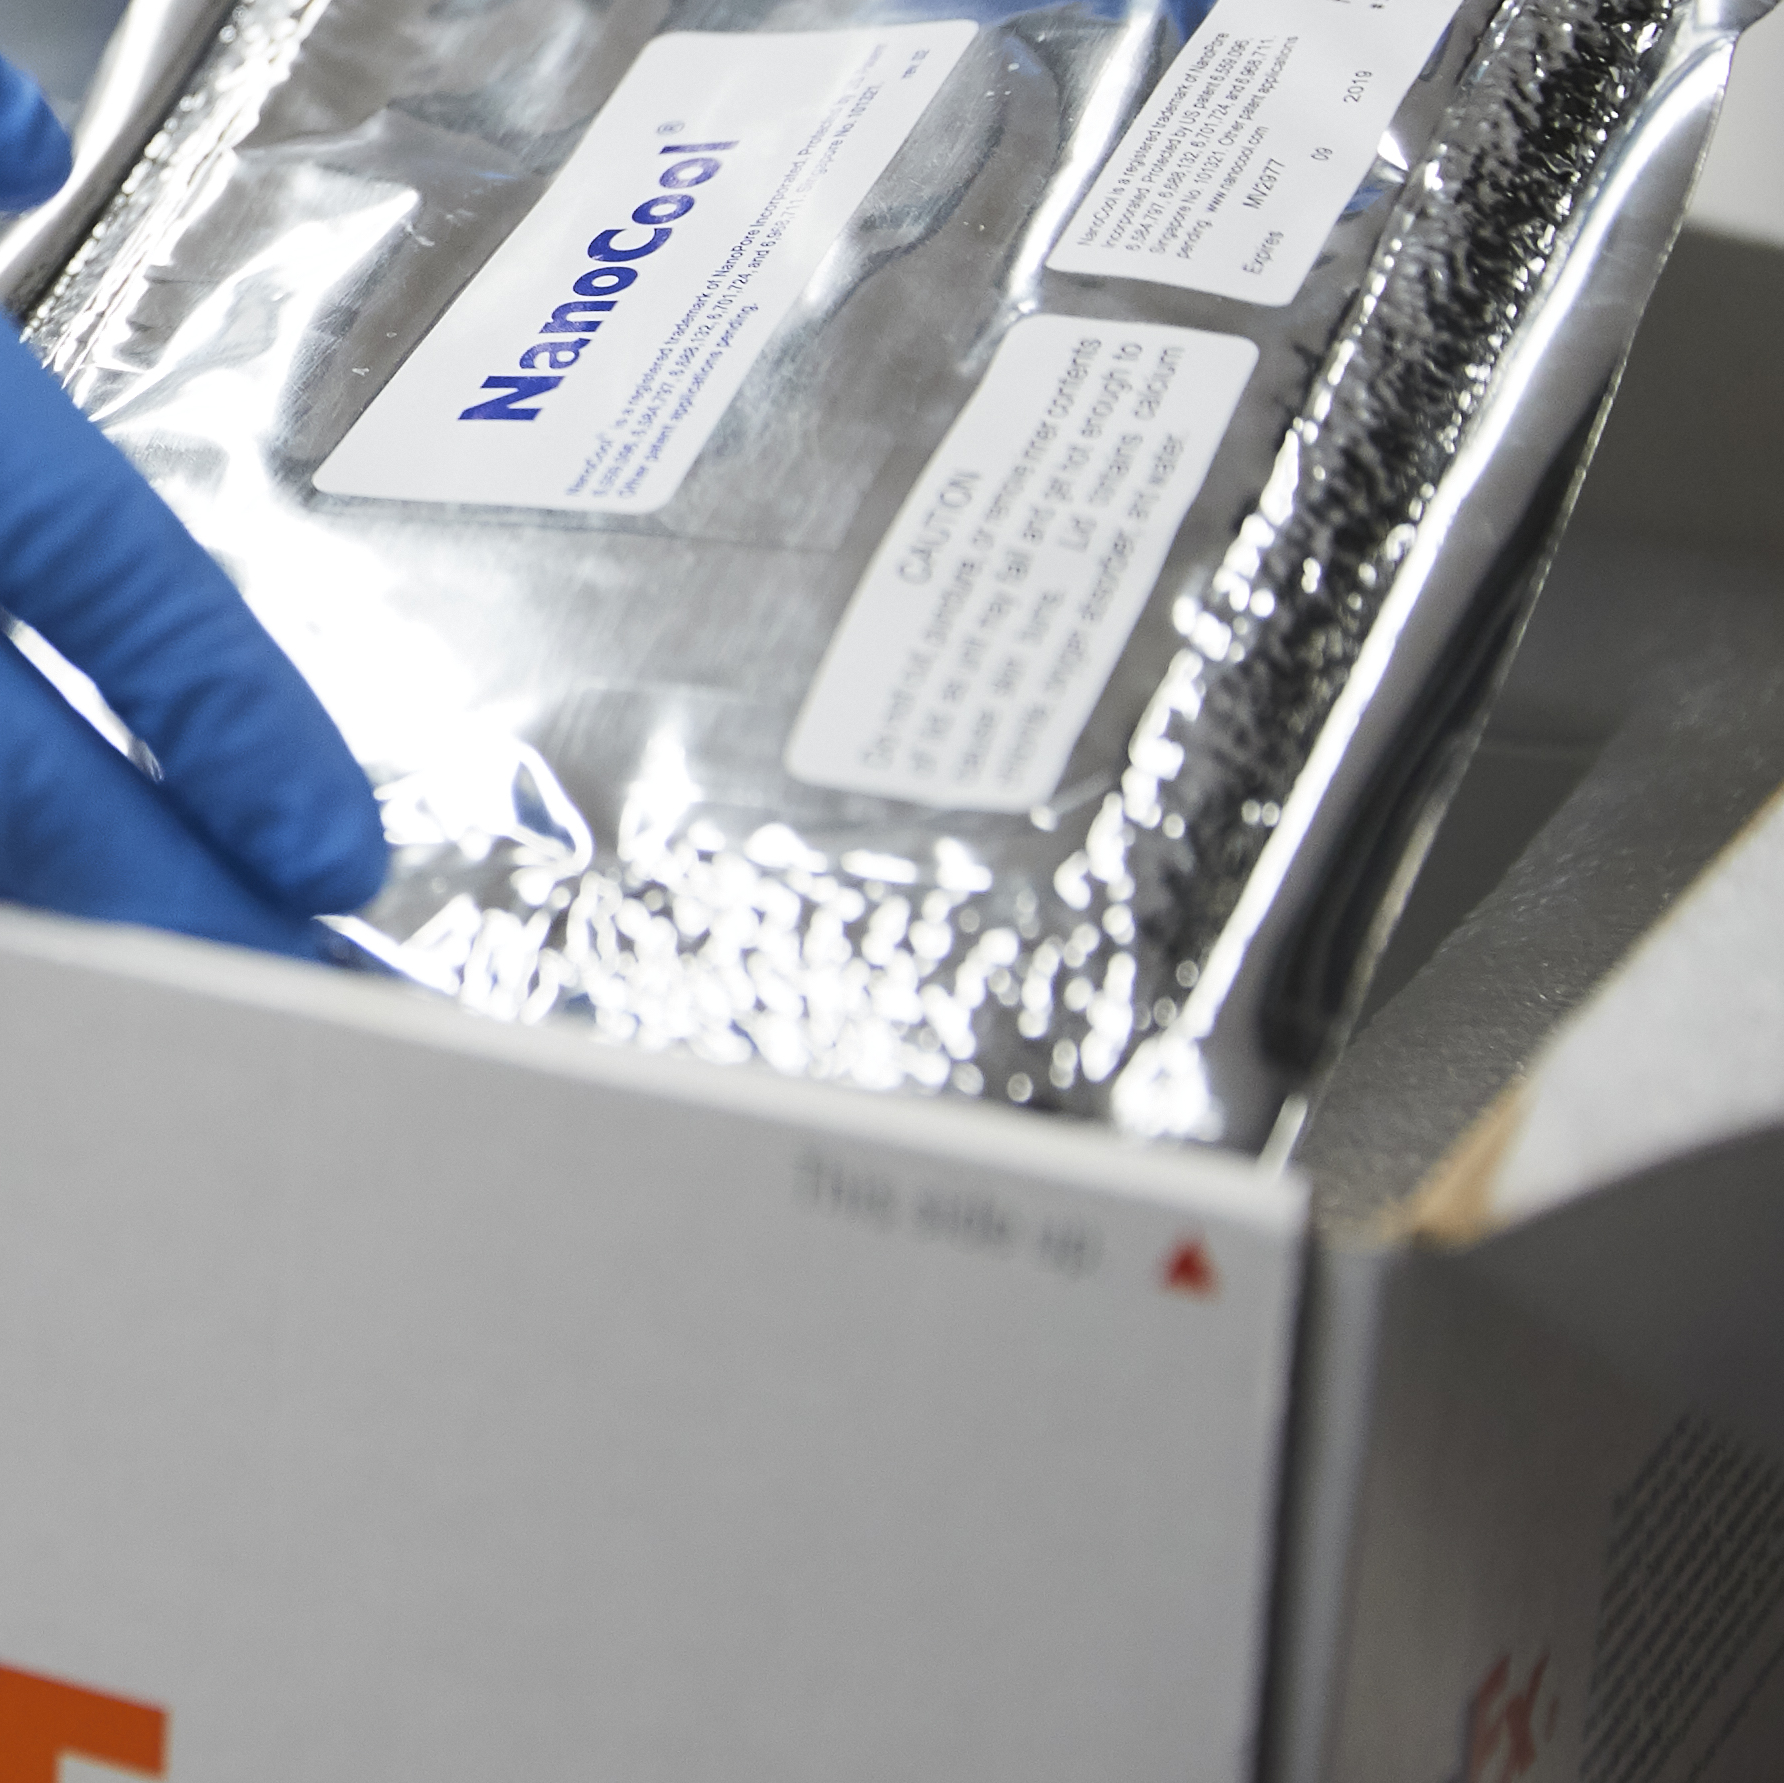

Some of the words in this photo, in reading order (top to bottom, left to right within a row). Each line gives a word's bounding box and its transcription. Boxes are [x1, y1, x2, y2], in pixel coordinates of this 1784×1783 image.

[1187, 31, 1230, 73] NanoPore
[1183, 71, 1199, 83] of
[1191, 80, 1221, 110] patent
[1223, 83, 1246, 101] and
[1150, 82, 1192, 129] trademark
[1177, 109, 1201, 125] US
[1216, 119, 1245, 146] Other
[1237, 93, 1266, 121] patent
[1121, 128, 1162, 177] registered
[1170, 124, 1194, 138] by
[1139, 137, 1182, 183] Protected
[1205, 125, 1269, 213] www.nanocool.com
[1240, 229, 1285, 275] Expires
[1309, 146, 1333, 161] 09
[1341, 69, 1373, 103] 2019
[1241, 156, 1285, 210] MV2977
[710, 228, 761, 278] NanoPore
[746, 248, 771, 268] and
[705, 278, 722, 290] of
[663, 291, 713, 345] trademark
[1045, 337, 1103, 417] contents
[1078, 367, 1134, 439] enough
[1111, 342, 1144, 361] to
[1131, 345, 1183, 419] calcium
[895, 470, 981, 584] CAUTION
